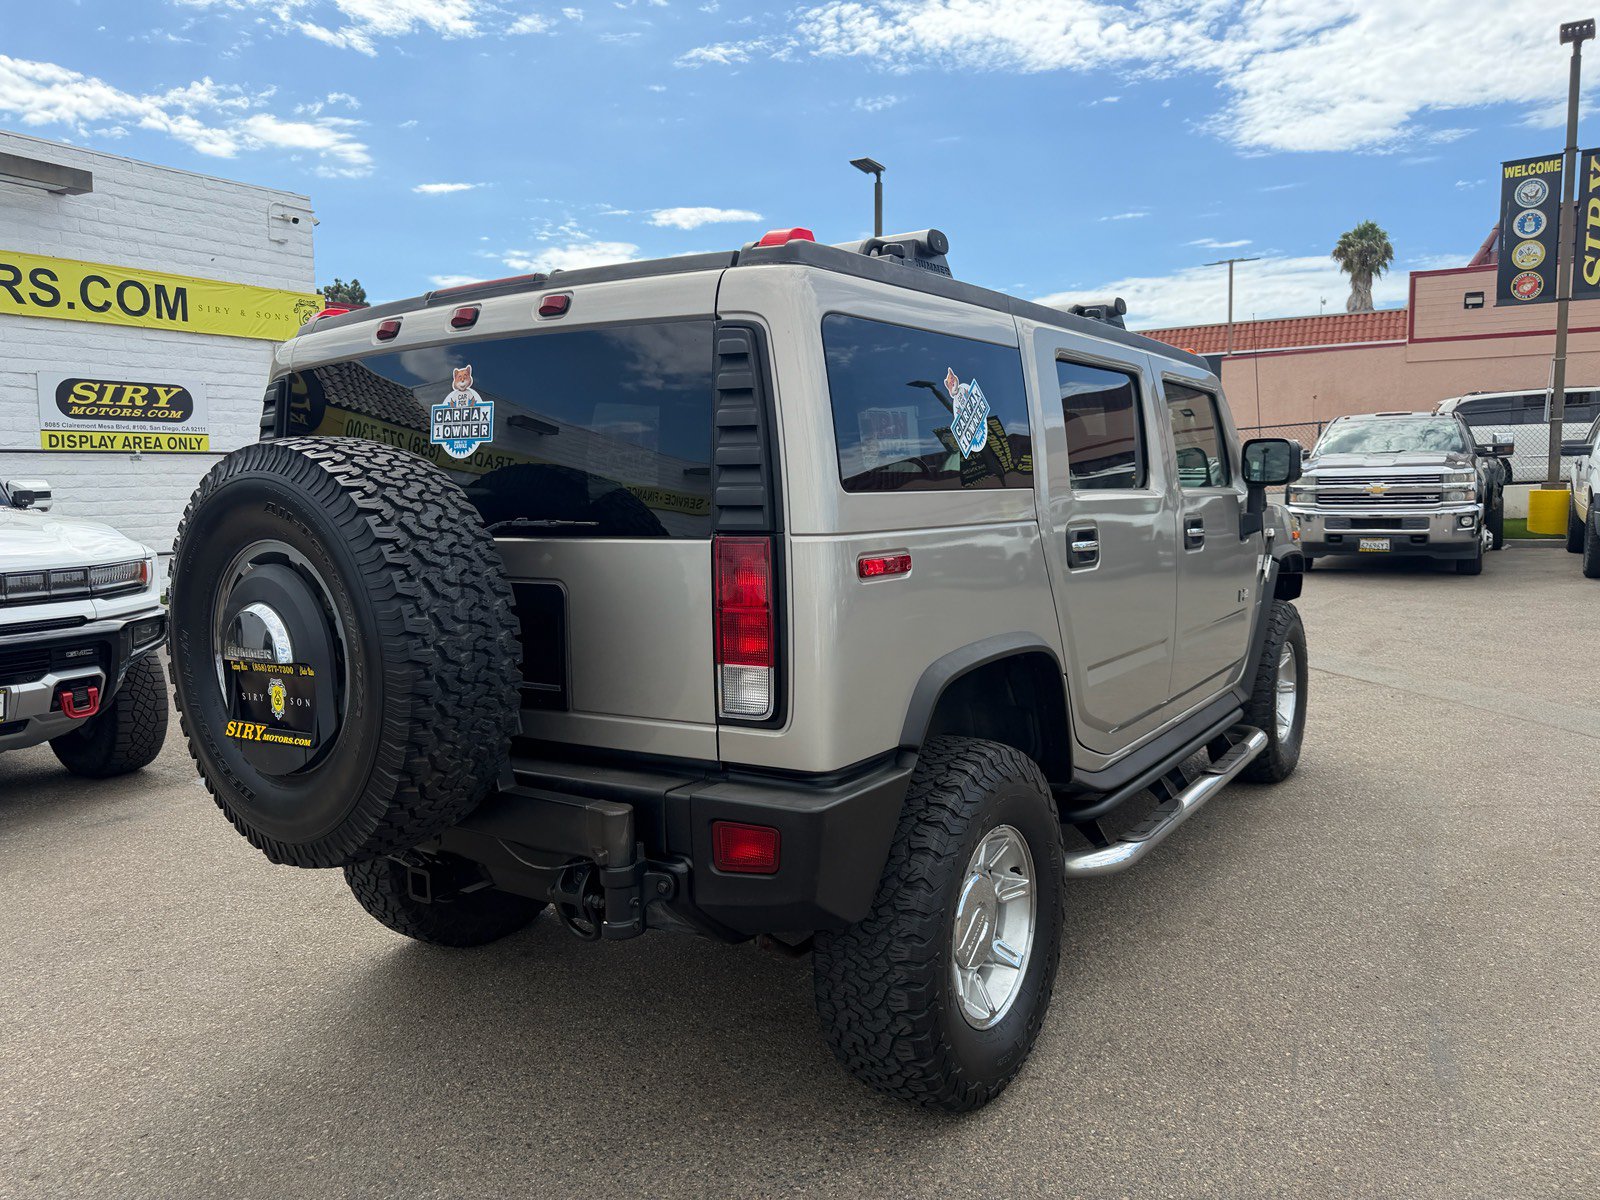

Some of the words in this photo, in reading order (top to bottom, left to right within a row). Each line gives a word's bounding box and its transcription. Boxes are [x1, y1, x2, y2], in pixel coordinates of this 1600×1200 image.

[1504, 159, 1561, 178] WELCOME
[0, 263, 189, 322] RS.COM
[198, 304, 229, 315] SIRY
[239, 309, 247, 317] &
[256, 312, 290, 322] SONS
[67, 382, 183, 408] SIRY
[69, 406, 184, 419] MOTORS.COM
[435, 408, 489, 422] CARFAX
[955, 391, 981, 436] CARFAX
[48, 434, 117, 449] DISPLAY
[121, 435, 163, 450] AREA
[167, 436, 204, 450] ONLY
[65, 648, 93, 658] GMC
[227, 646, 272, 660] HUMMER
[241, 692, 264, 702] SIRY
[290, 697, 311, 707] SON
